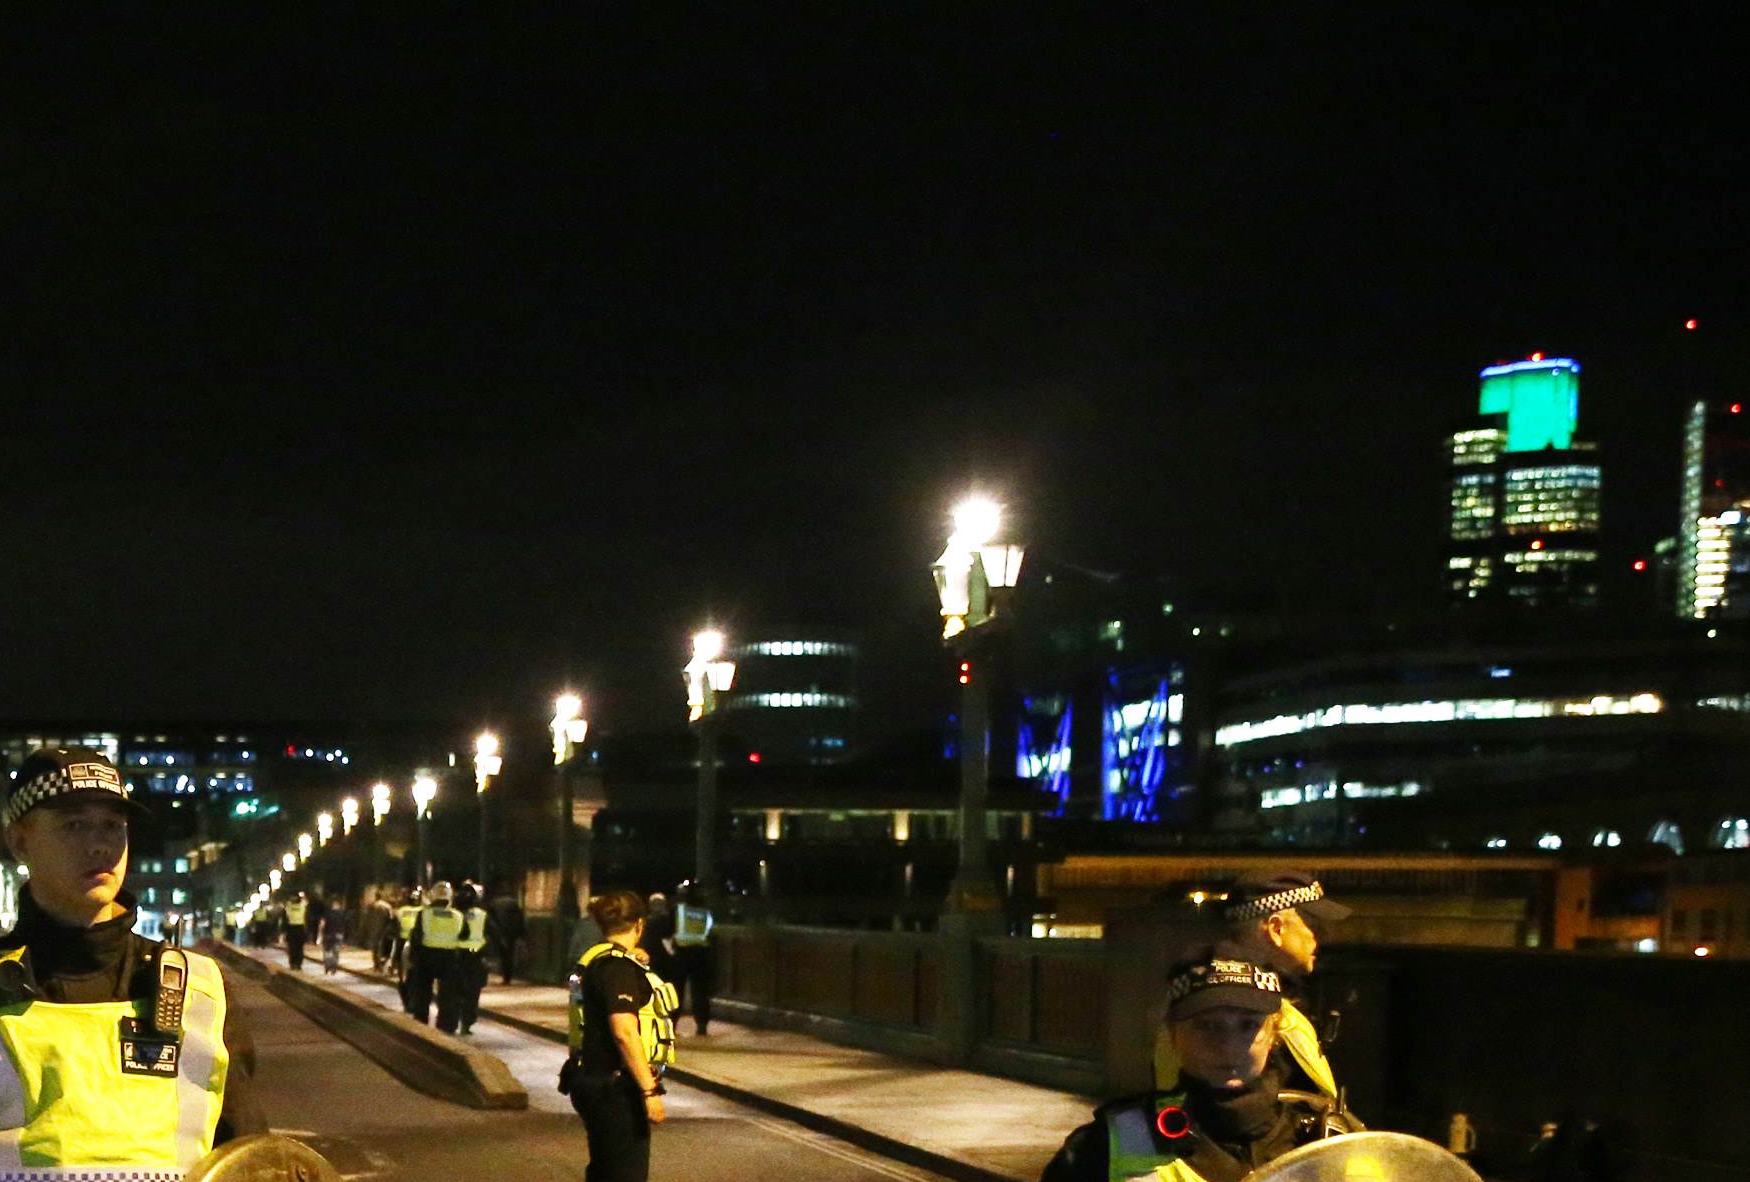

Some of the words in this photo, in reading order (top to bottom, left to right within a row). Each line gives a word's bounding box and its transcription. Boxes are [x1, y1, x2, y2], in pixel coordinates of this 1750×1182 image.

[72, 780, 97, 789] POLICE
[97, 780, 122, 795] OFFICER
[1215, 965, 1242, 974] POLICE
[1220, 975, 1252, 984] OFFICER
[125, 1060, 148, 1070] POL
